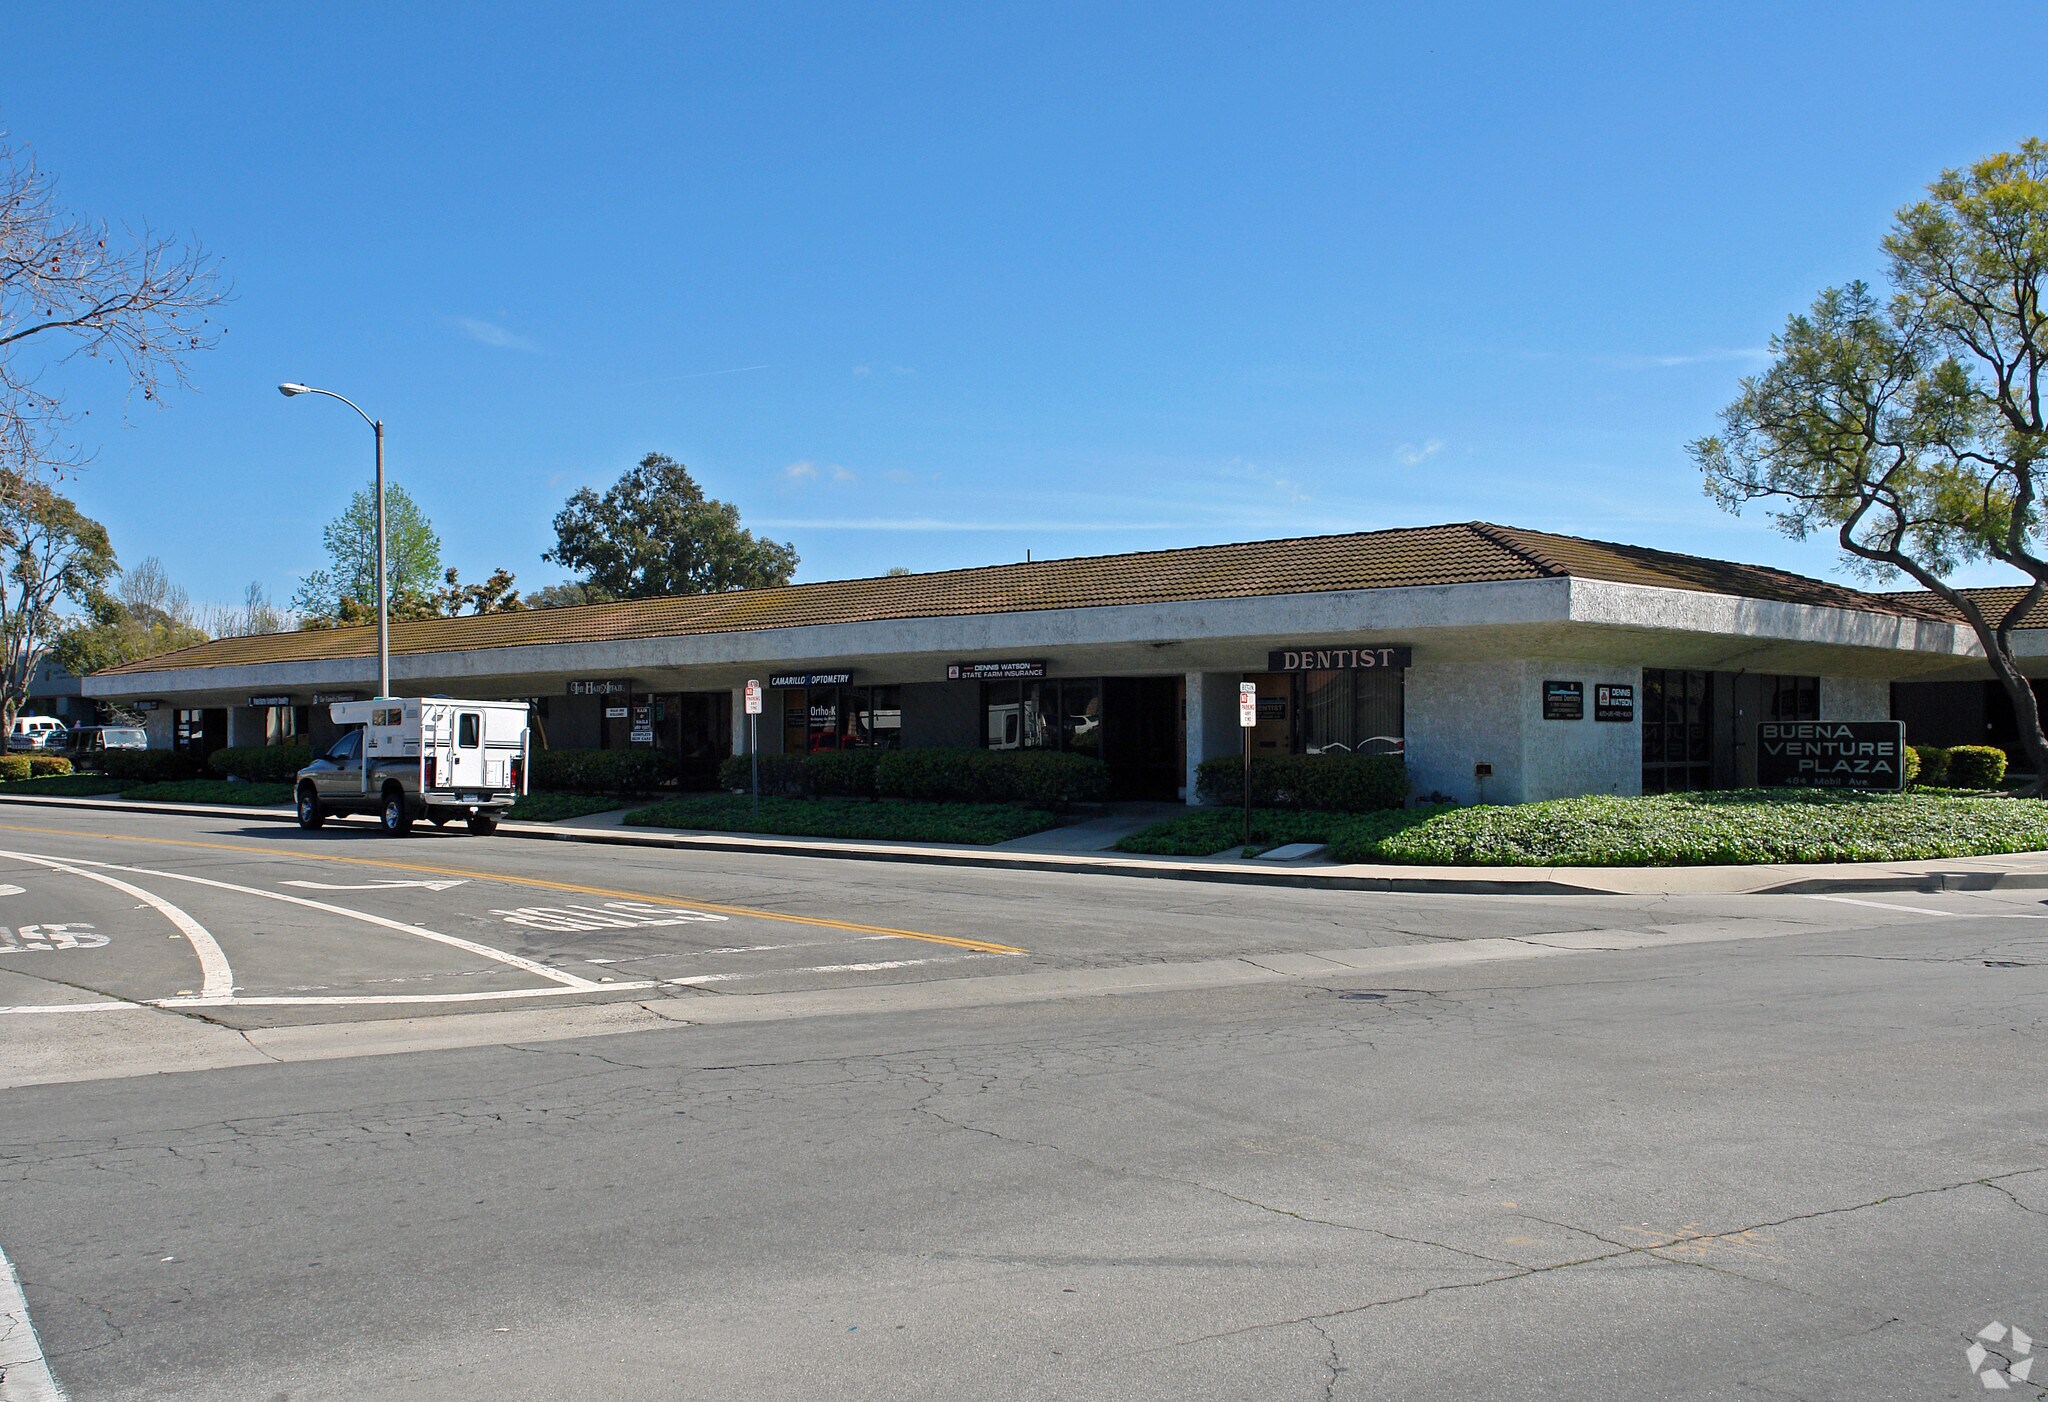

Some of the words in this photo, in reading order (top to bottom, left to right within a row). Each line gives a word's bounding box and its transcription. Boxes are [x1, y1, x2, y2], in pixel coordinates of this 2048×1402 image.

[1284, 649, 1394, 670] DENTIST
[1004, 669, 1043, 677] INSURANCE
[771, 677, 806, 685] CAMARILLO
[811, 674, 849, 684] OPTOMETRY
[1611, 688, 1631, 696] DENNIS
[1564, 694, 1581, 703] Dentistry
[1610, 698, 1633, 706] WATSON
[810, 705, 836, 716] Ortho-K
[1763, 724, 1854, 739] BUENA
[1764, 742, 1893, 756] VENTURE
[1799, 759, 1893, 773] PLAZA
[1814, 777, 1841, 786] Mobil
